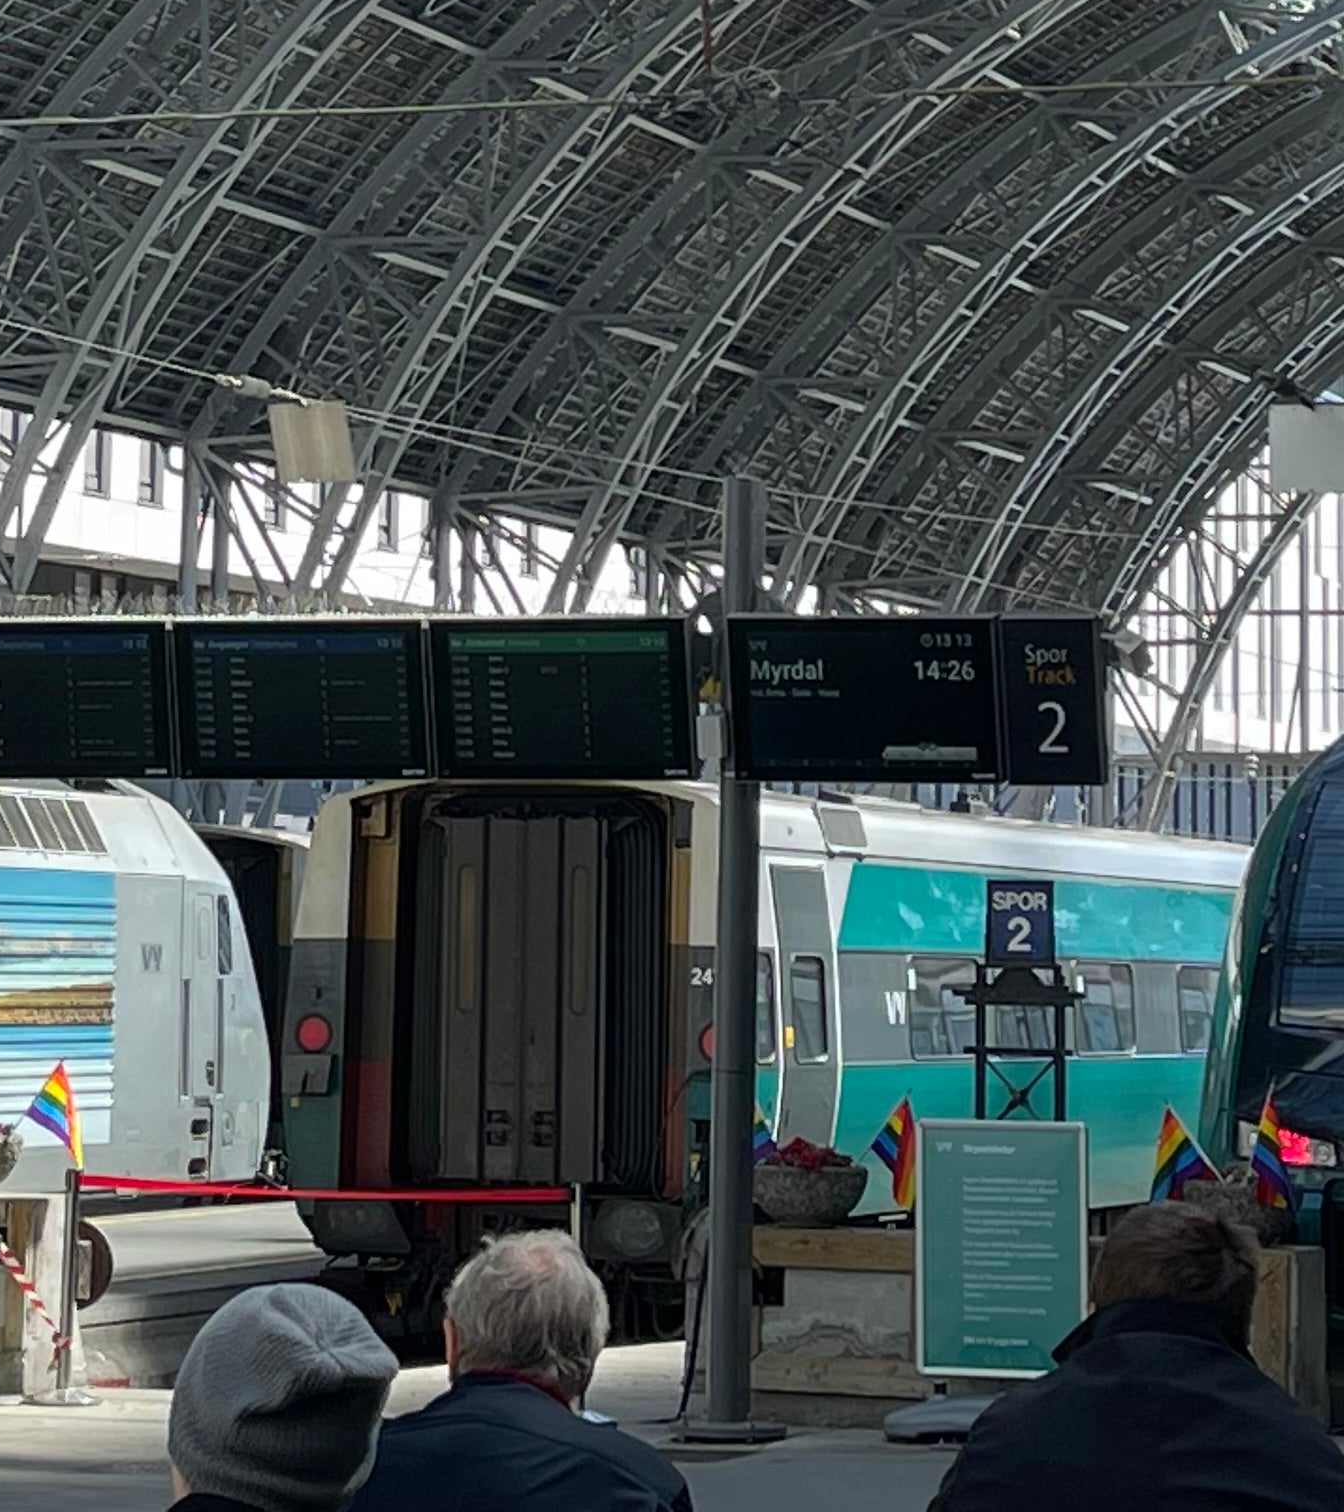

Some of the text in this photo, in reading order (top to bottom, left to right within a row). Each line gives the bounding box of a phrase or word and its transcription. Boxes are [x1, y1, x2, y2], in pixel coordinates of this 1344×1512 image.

[1024, 643, 1069, 666] Spor
[749, 659, 824, 686] Myrdal
[913, 660, 975, 682] 14:26
[1026, 666, 1077, 685] Track
[1036, 700, 1071, 755] 2
[992, 891, 1048, 911] SPOR
[1007, 916, 1032, 952] 2
